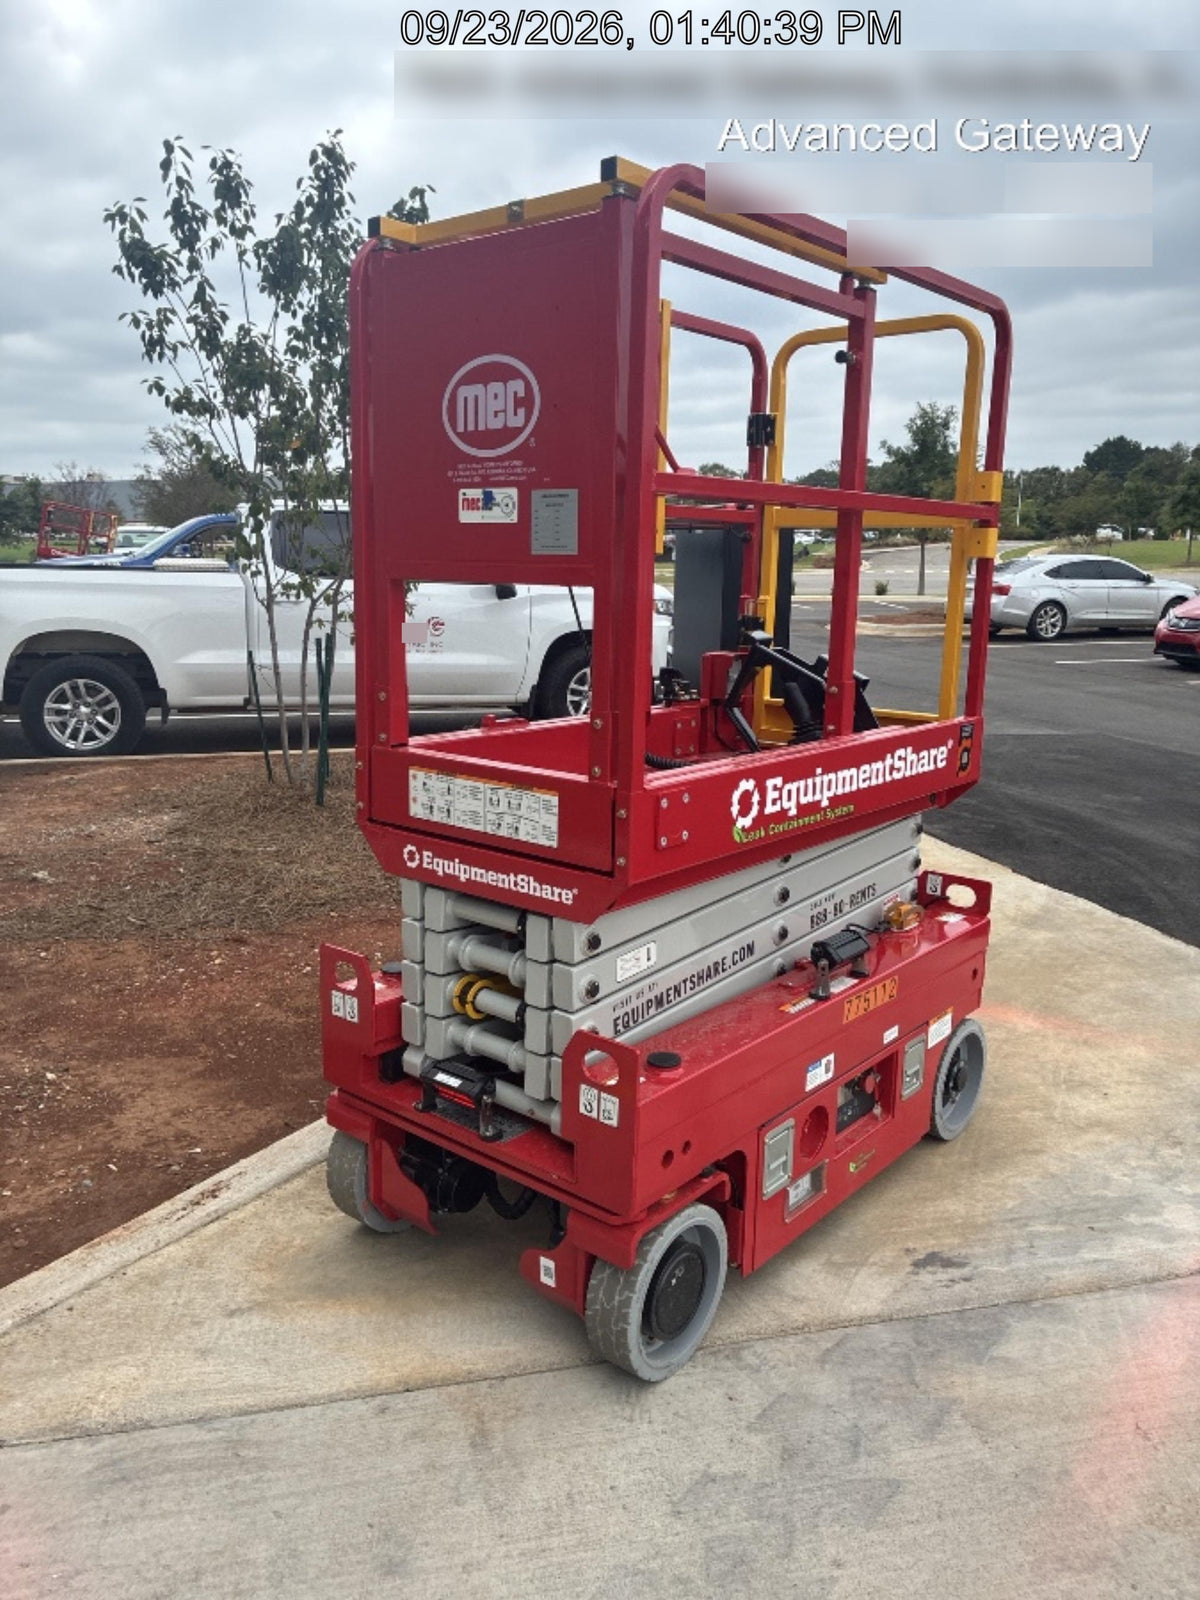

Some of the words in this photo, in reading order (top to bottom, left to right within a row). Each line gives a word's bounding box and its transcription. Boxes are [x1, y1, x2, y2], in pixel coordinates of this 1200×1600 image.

[763, 744, 950, 817] EquipmentShare
[421, 850, 574, 906] EquipmentShare
[613, 940, 755, 1036] EQUIPMENTSHARE.COM
[845, 978, 898, 1021] 775112
